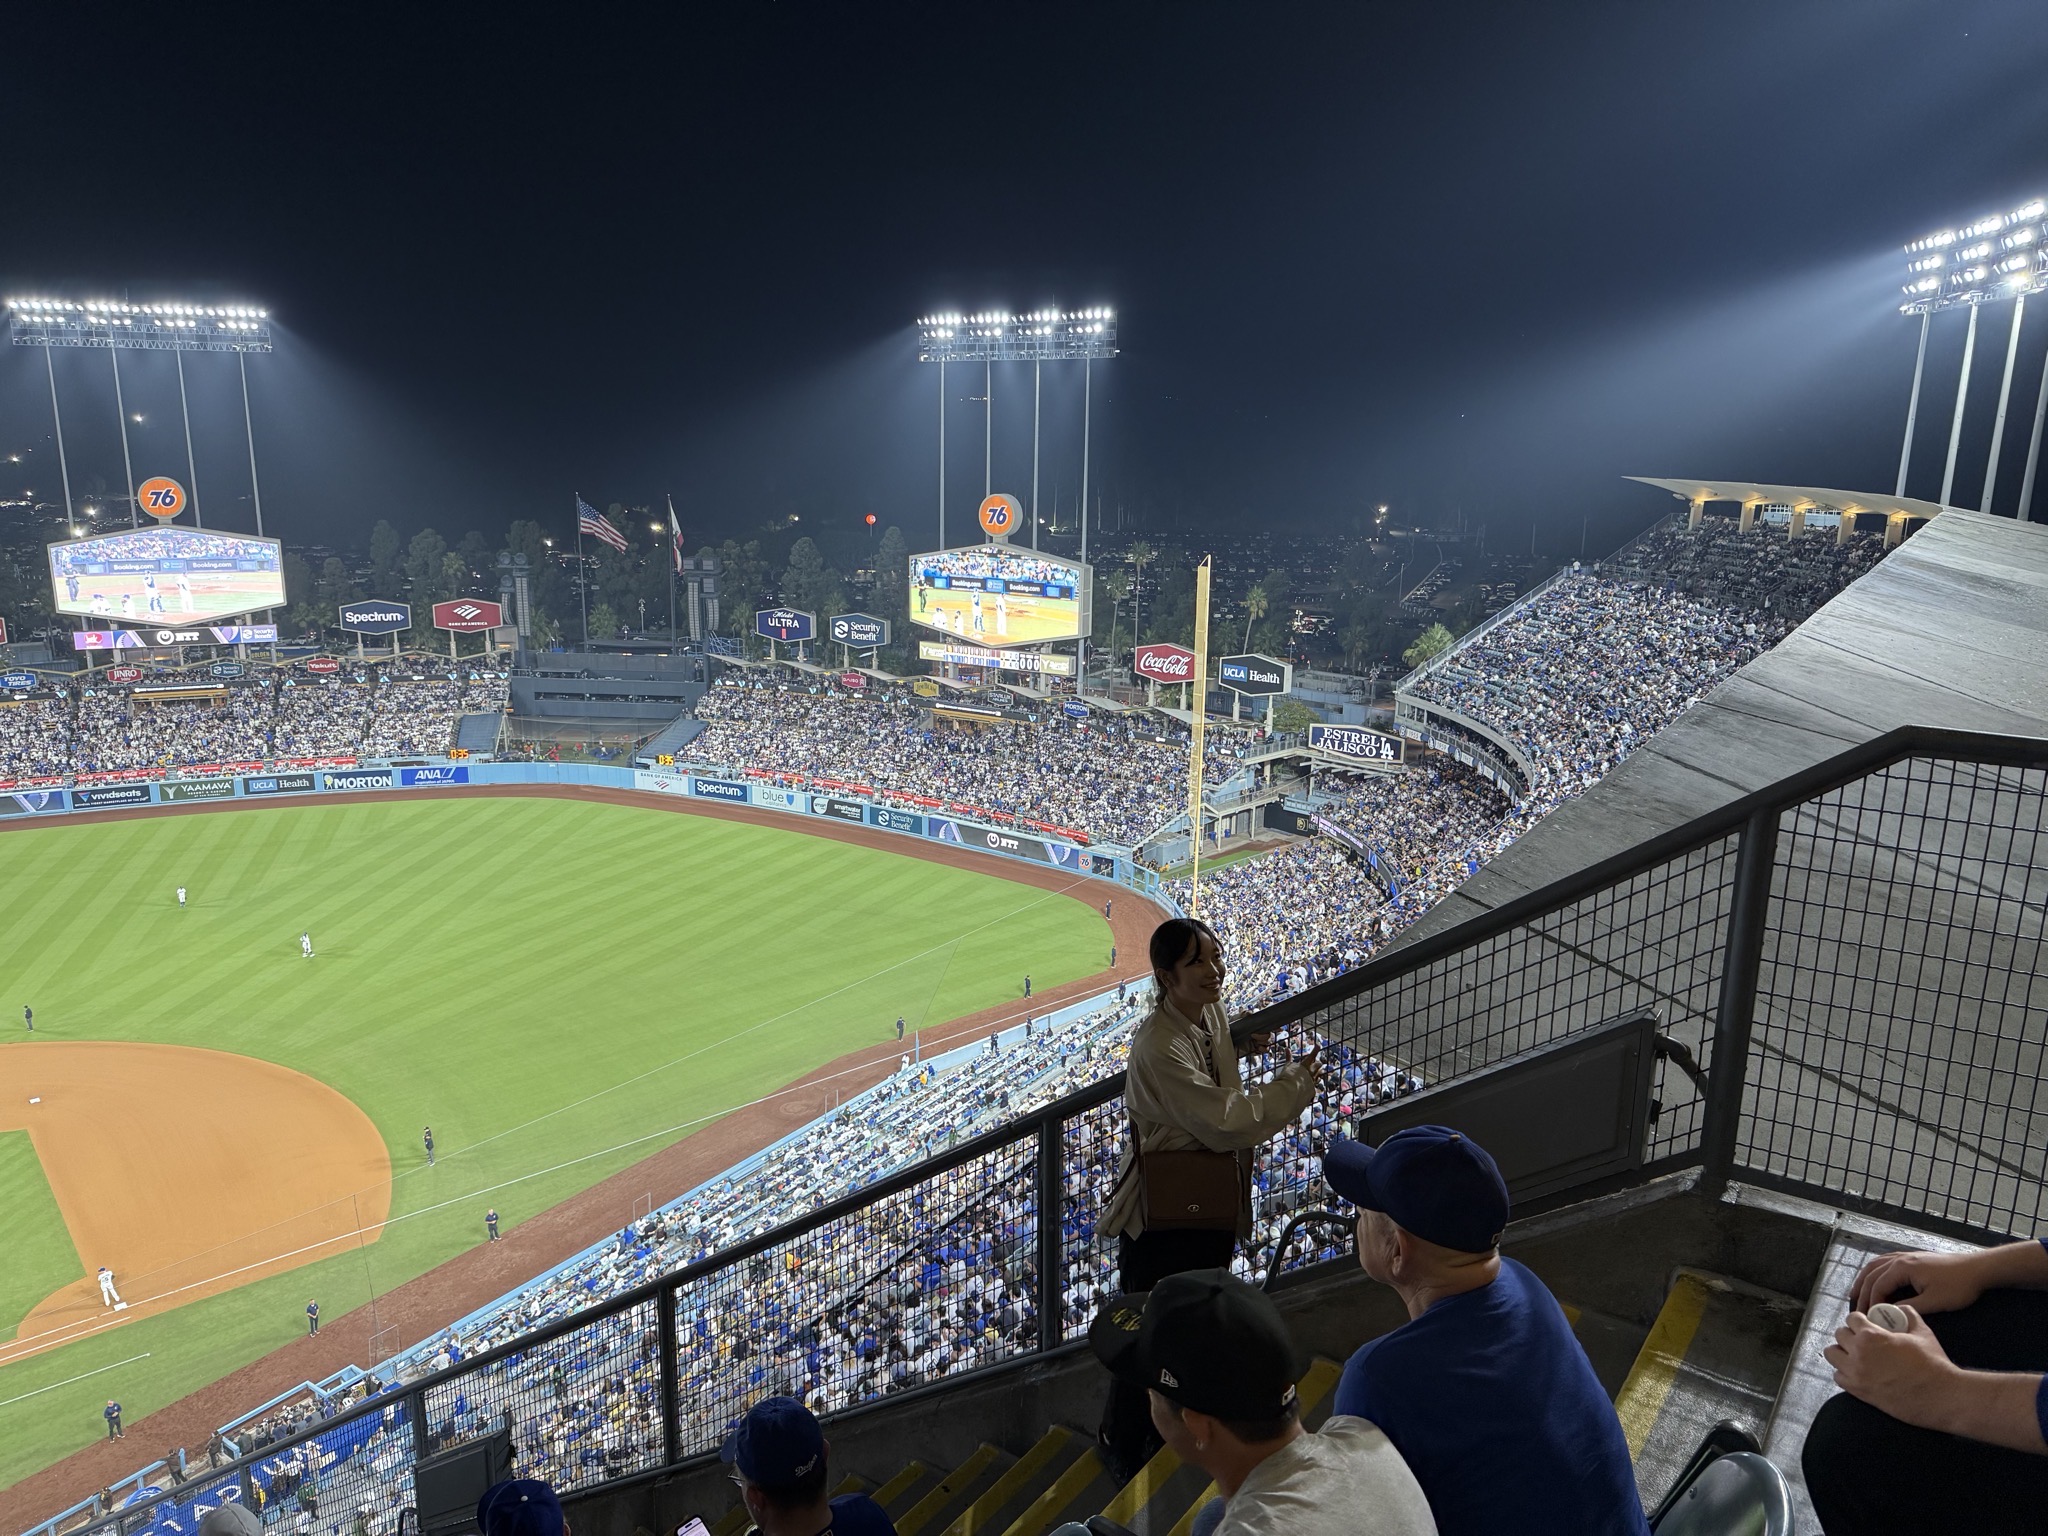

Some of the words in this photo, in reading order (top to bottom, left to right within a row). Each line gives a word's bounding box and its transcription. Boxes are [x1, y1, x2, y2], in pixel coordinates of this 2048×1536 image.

[149, 488, 177, 508] 76
[986, 505, 1009, 527] 76
[952, 579, 981, 588] Booking.com
[1009, 584, 1040, 593] Booking.com
[345, 611, 401, 625] Spectrum
[768, 617, 800, 628] ULTRA
[850, 622, 880, 633] Security
[851, 631, 877, 641] Benefit
[1140, 652, 1191, 676] Coca-Cola
[114, 670, 137, 680] JINRO
[1223, 667, 1245, 678] UCLA
[1249, 670, 1280, 684] Health
[1064, 703, 1087, 712] MORTON
[1316, 737, 1377, 757] JALISCO
[1323, 727, 1380, 747] ESTREL
[1380, 737, 1394, 760] LA
[450, 749, 469, 760] 0:35
[658, 755, 674, 766] 0:35
[415, 769, 441, 780] ANA
[278, 778, 310, 789] Health
[334, 776, 392, 789] MORTON
[696, 780, 741, 797] Spectrum
[91, 789, 141, 800] vividseats
[762, 789, 784, 802] blue
[891, 812, 913, 824] Security
[891, 821, 911, 831] Benefit
[1000, 837, 1018, 850] NTT
[1080, 858, 1090, 866] 76
